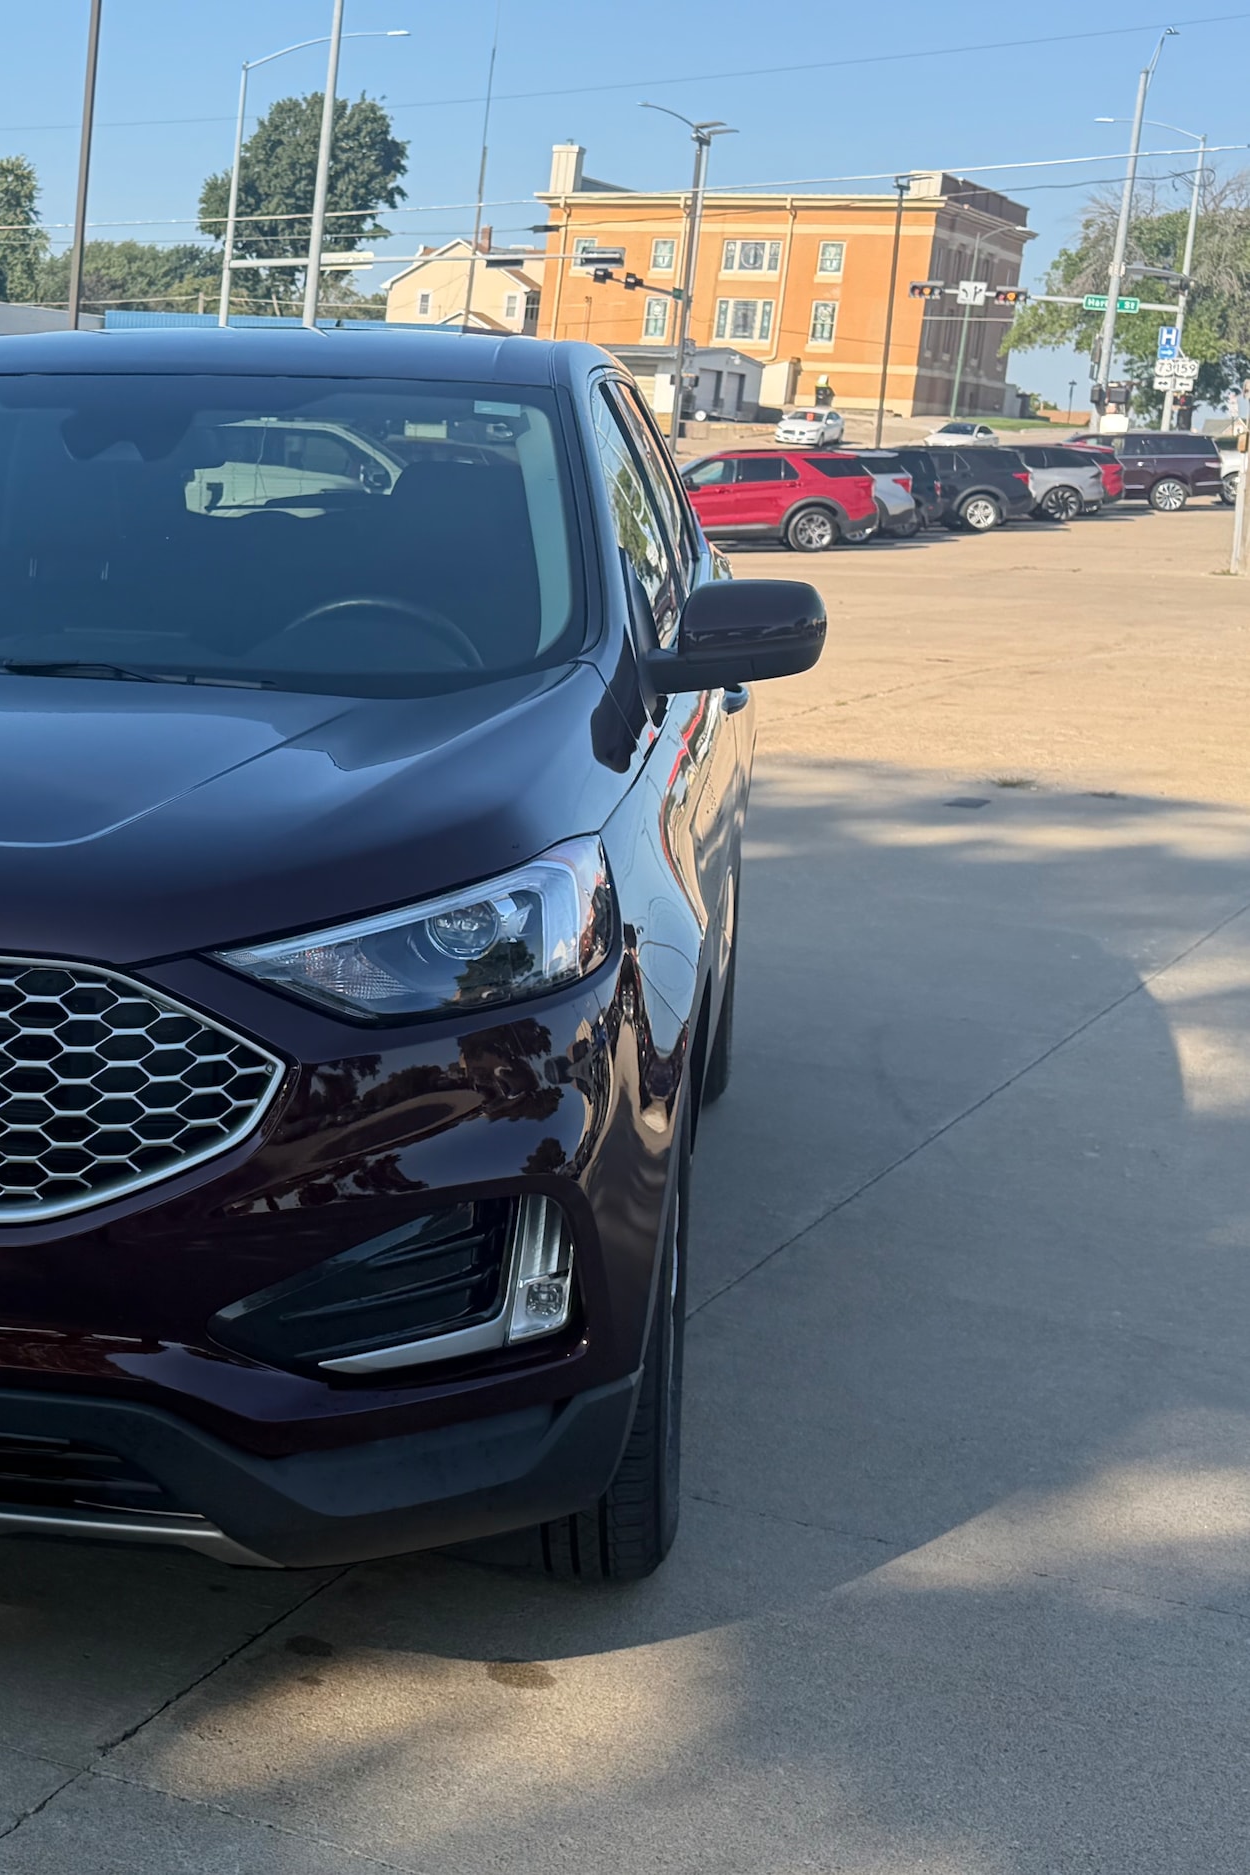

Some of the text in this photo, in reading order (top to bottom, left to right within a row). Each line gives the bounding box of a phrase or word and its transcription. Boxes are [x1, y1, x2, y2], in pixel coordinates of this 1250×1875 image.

[1087, 298, 1136, 310] Har St
[1161, 327, 1177, 346] H
[1158, 362, 1173, 372] 73
[1176, 362, 1196, 374] 159
